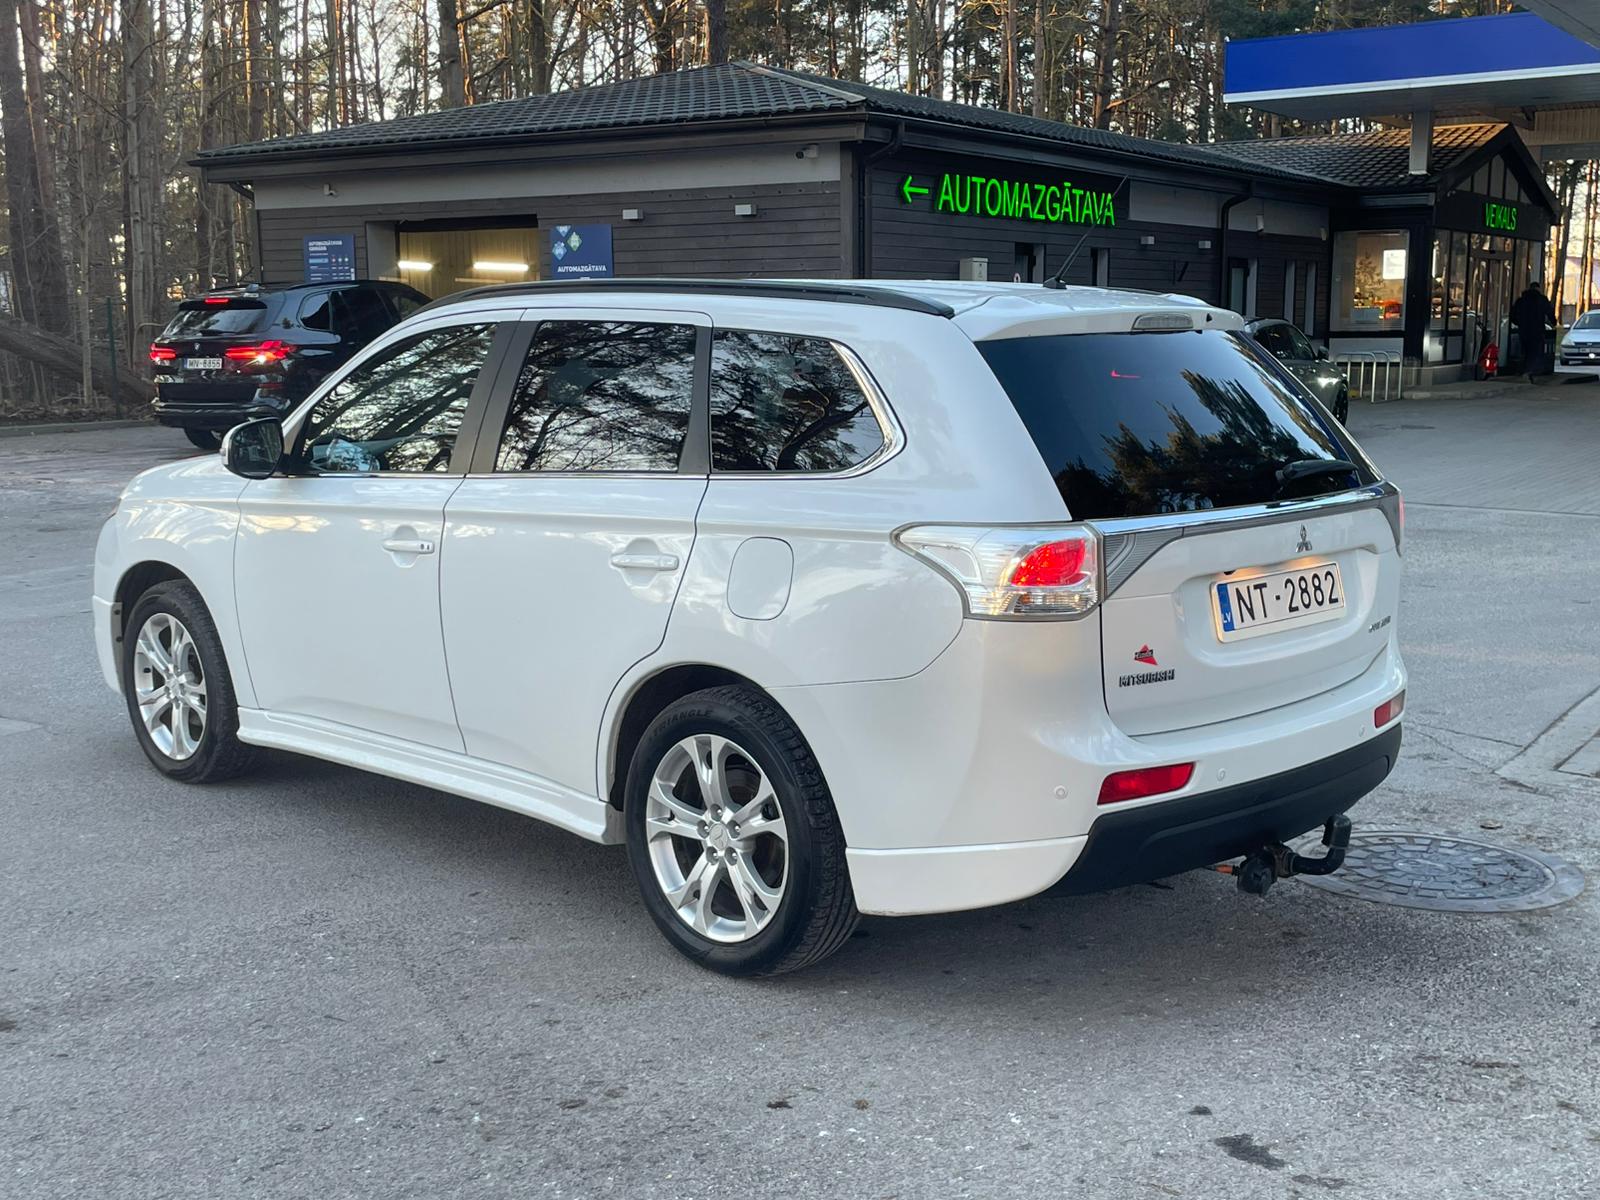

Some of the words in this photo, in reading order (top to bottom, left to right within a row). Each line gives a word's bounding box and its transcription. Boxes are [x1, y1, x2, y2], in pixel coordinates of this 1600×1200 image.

[937, 173, 1116, 226] AUTOMAZGĀTAVA
[1485, 203, 1517, 231] VEIKALS
[557, 264, 607, 273] AUTOMAZGĀTAVA
[1235, 570, 1339, 623] NT-2882
[1221, 612, 1231, 624] LV
[1119, 669, 1176, 688] MITSUBISHI
